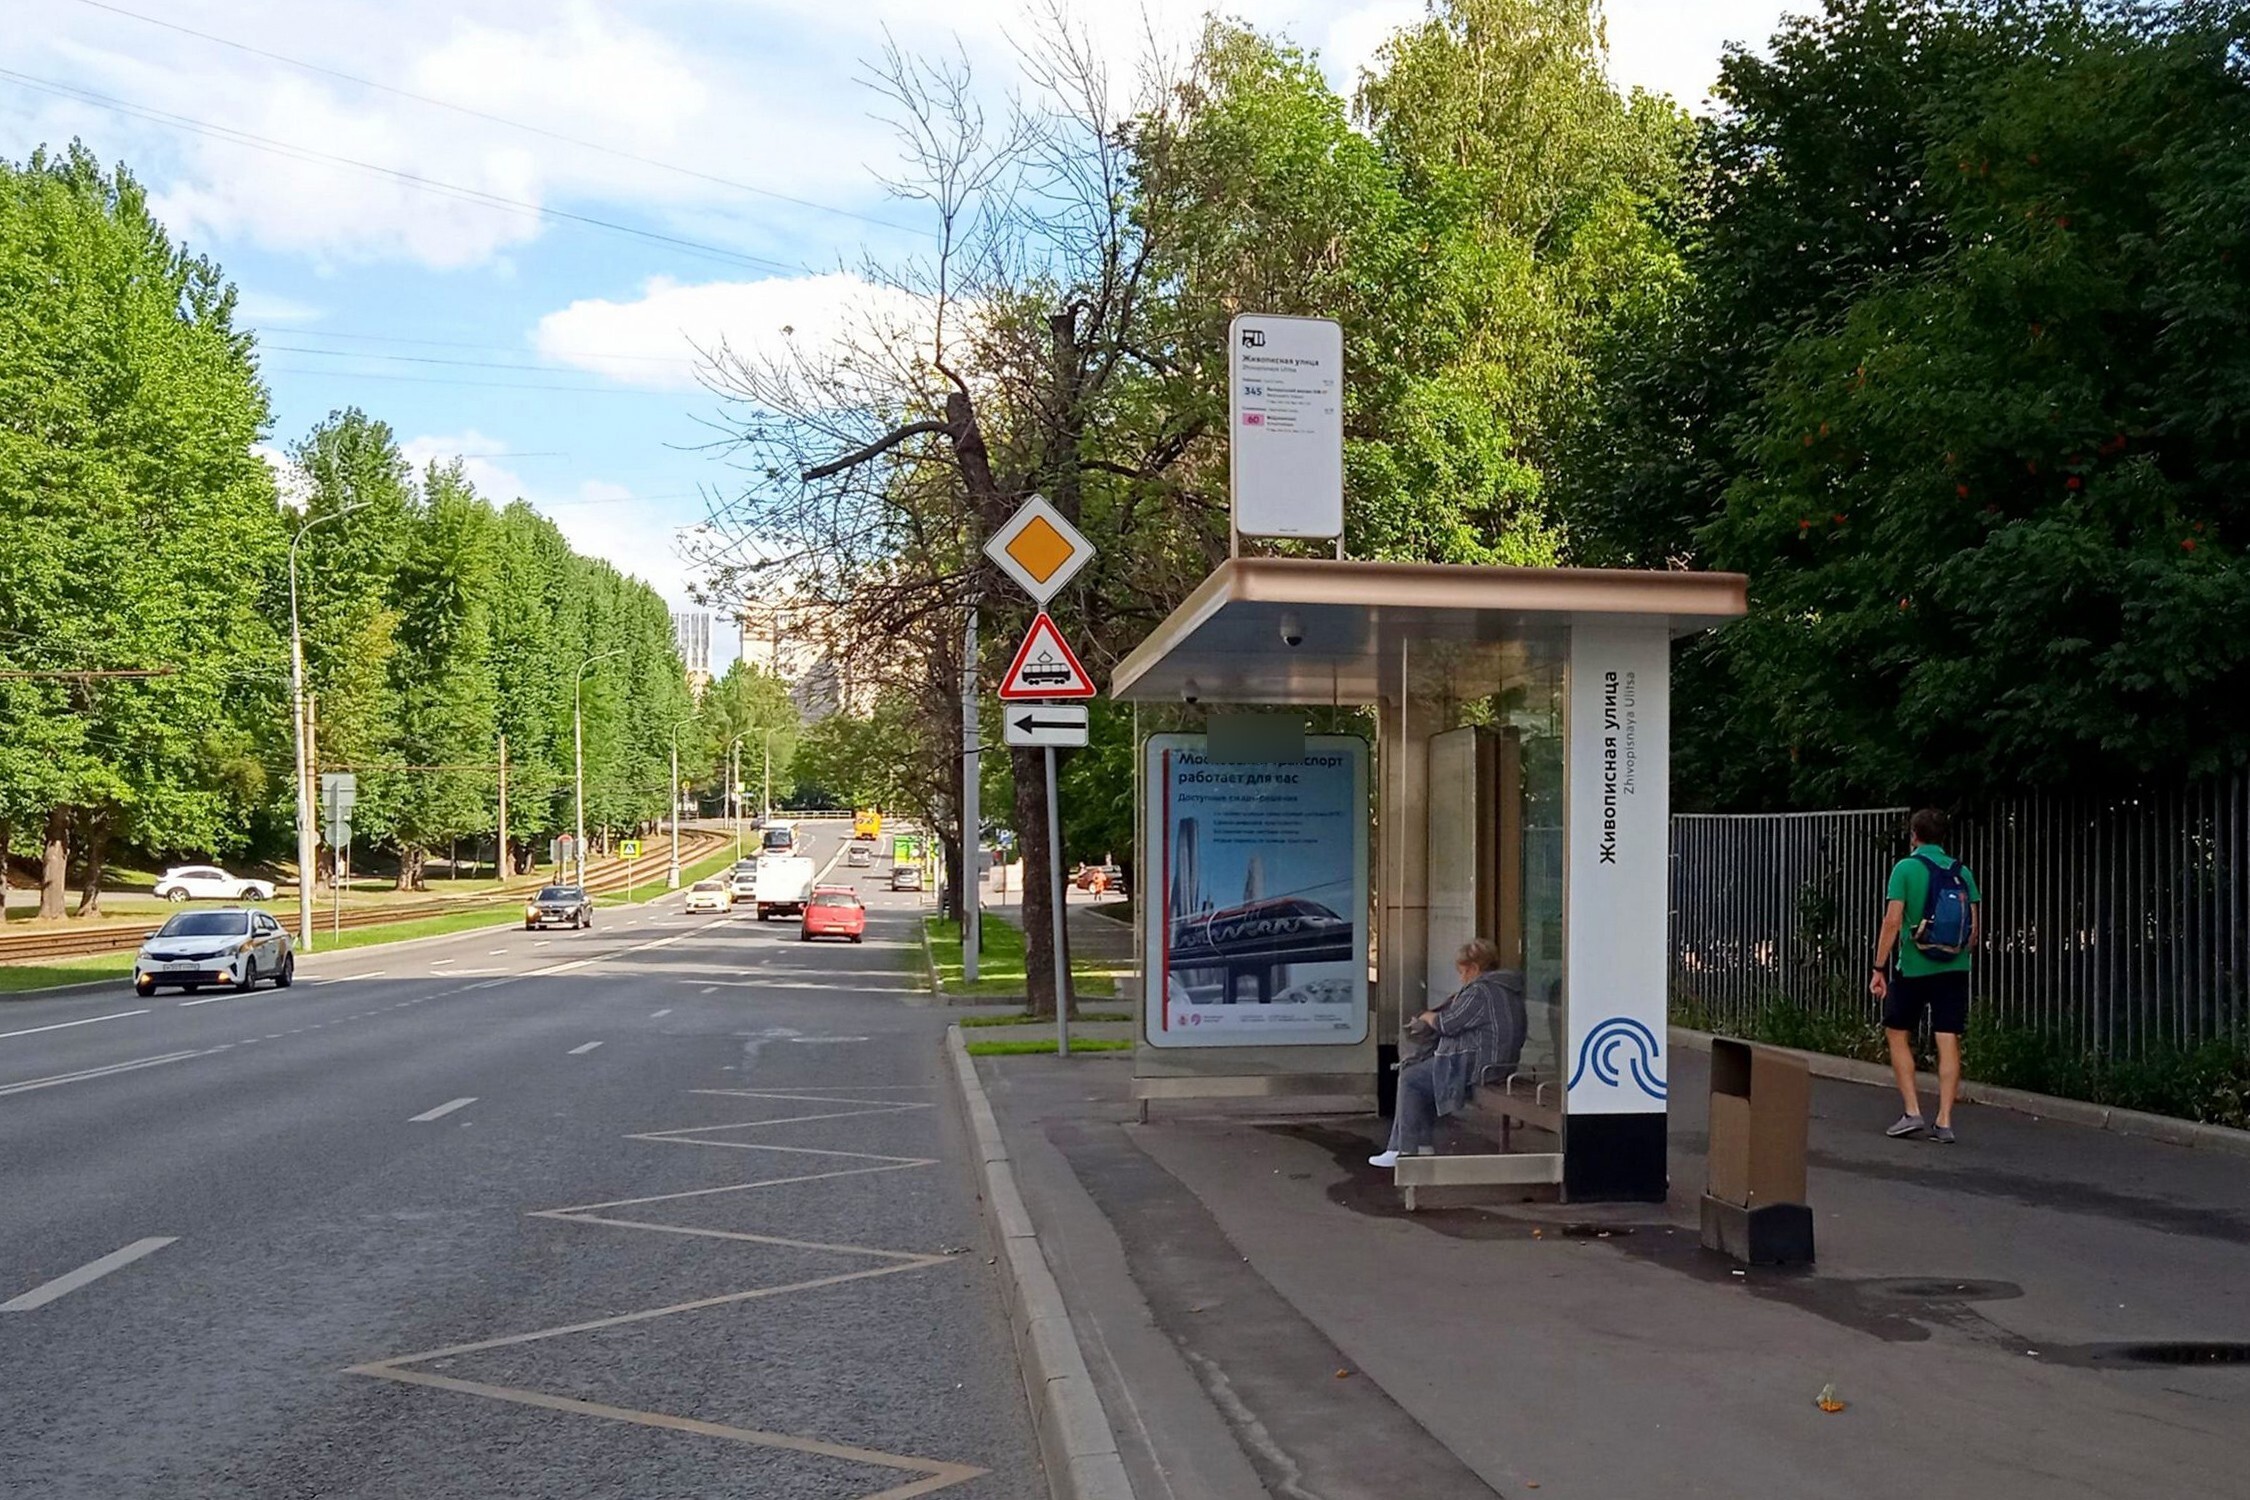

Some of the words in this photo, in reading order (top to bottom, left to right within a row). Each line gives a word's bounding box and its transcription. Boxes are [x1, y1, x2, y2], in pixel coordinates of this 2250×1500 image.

[1244, 386, 1262, 396] 345
[1248, 415, 1260, 425] 60
[1604, 671, 1620, 730] улица
[1624, 672, 1636, 708] Ulitsa
[1624, 712, 1637, 795] Zhivopisnaya
[1178, 771, 1243, 784] работает
[1246, 774, 1272, 785] для
[1600, 736, 1617, 864] Живописная
